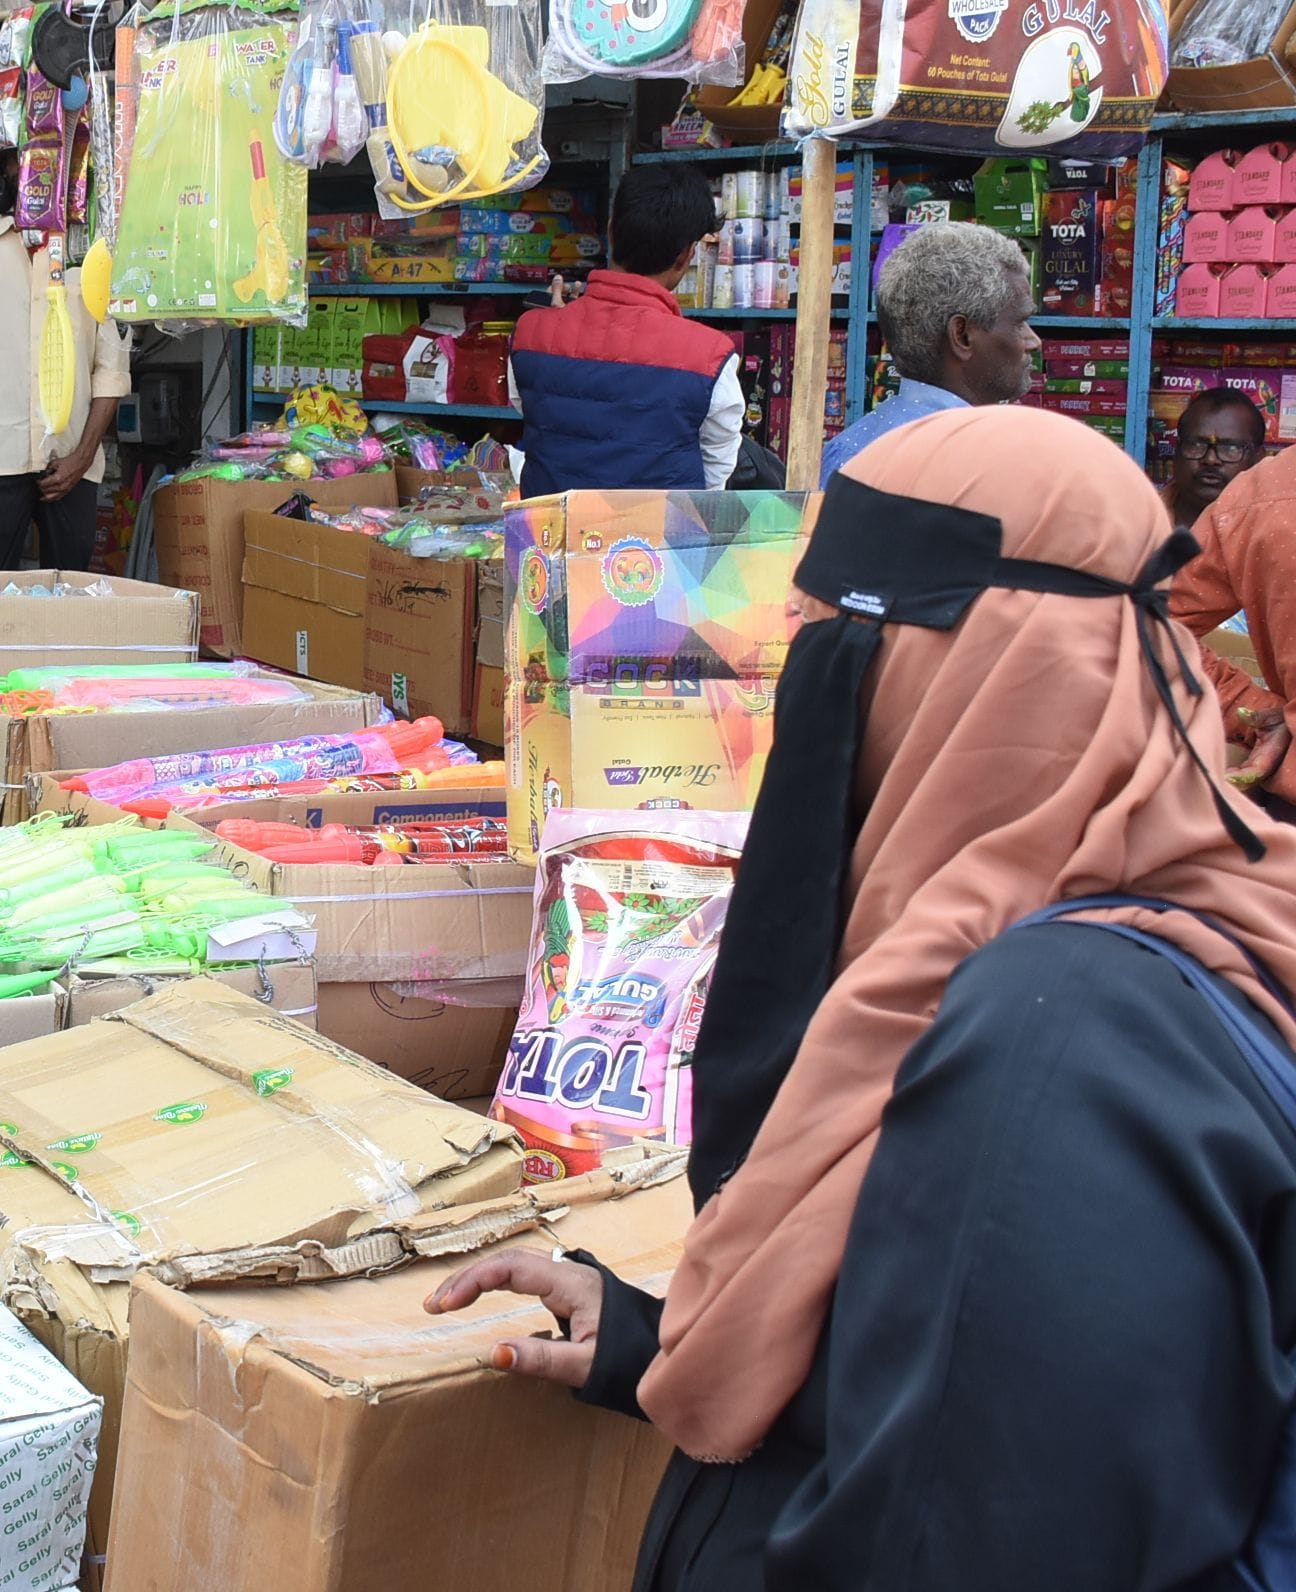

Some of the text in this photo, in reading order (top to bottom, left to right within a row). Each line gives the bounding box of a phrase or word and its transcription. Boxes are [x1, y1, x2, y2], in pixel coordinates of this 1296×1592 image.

[970, 20, 990, 32] PACK
[1023, 0, 1110, 43] GULAL
[246, 56, 266, 64] TANK
[950, 54, 991, 68] Net Content:
[832, 41, 850, 116] GULAL
[927, 67, 1007, 83] 60 Pouches of Tota Gulal
[33, 90, 53, 101] GOLD
[26, 186, 50, 197] GOLD
[179, 193, 210, 206] HOLI
[1050, 225, 1086, 238] TOTA
[1045, 260, 1089, 273] GULAL
[1162, 376, 1192, 387] TOTA
[1226, 378, 1256, 389] TOTA
[586, 539, 601, 549] No.1
[587, 661, 699, 690] COCK
[604, 699, 682, 709] BRAND
[639, 764, 721, 787] Herbal
[648, 799, 680, 809] COCK
[378, 808, 480, 828] Components
[503, 1031, 650, 1120] TOTA
[525, 1156, 554, 1177] RB
[16, 1424, 57, 1446] Gelly
[3, 1460, 73, 1514] Saral Gelly
[4, 1509, 37, 1535] Gelly
[17, 1522, 52, 1552] Saral
[19, 1545, 51, 1572] Gelly
